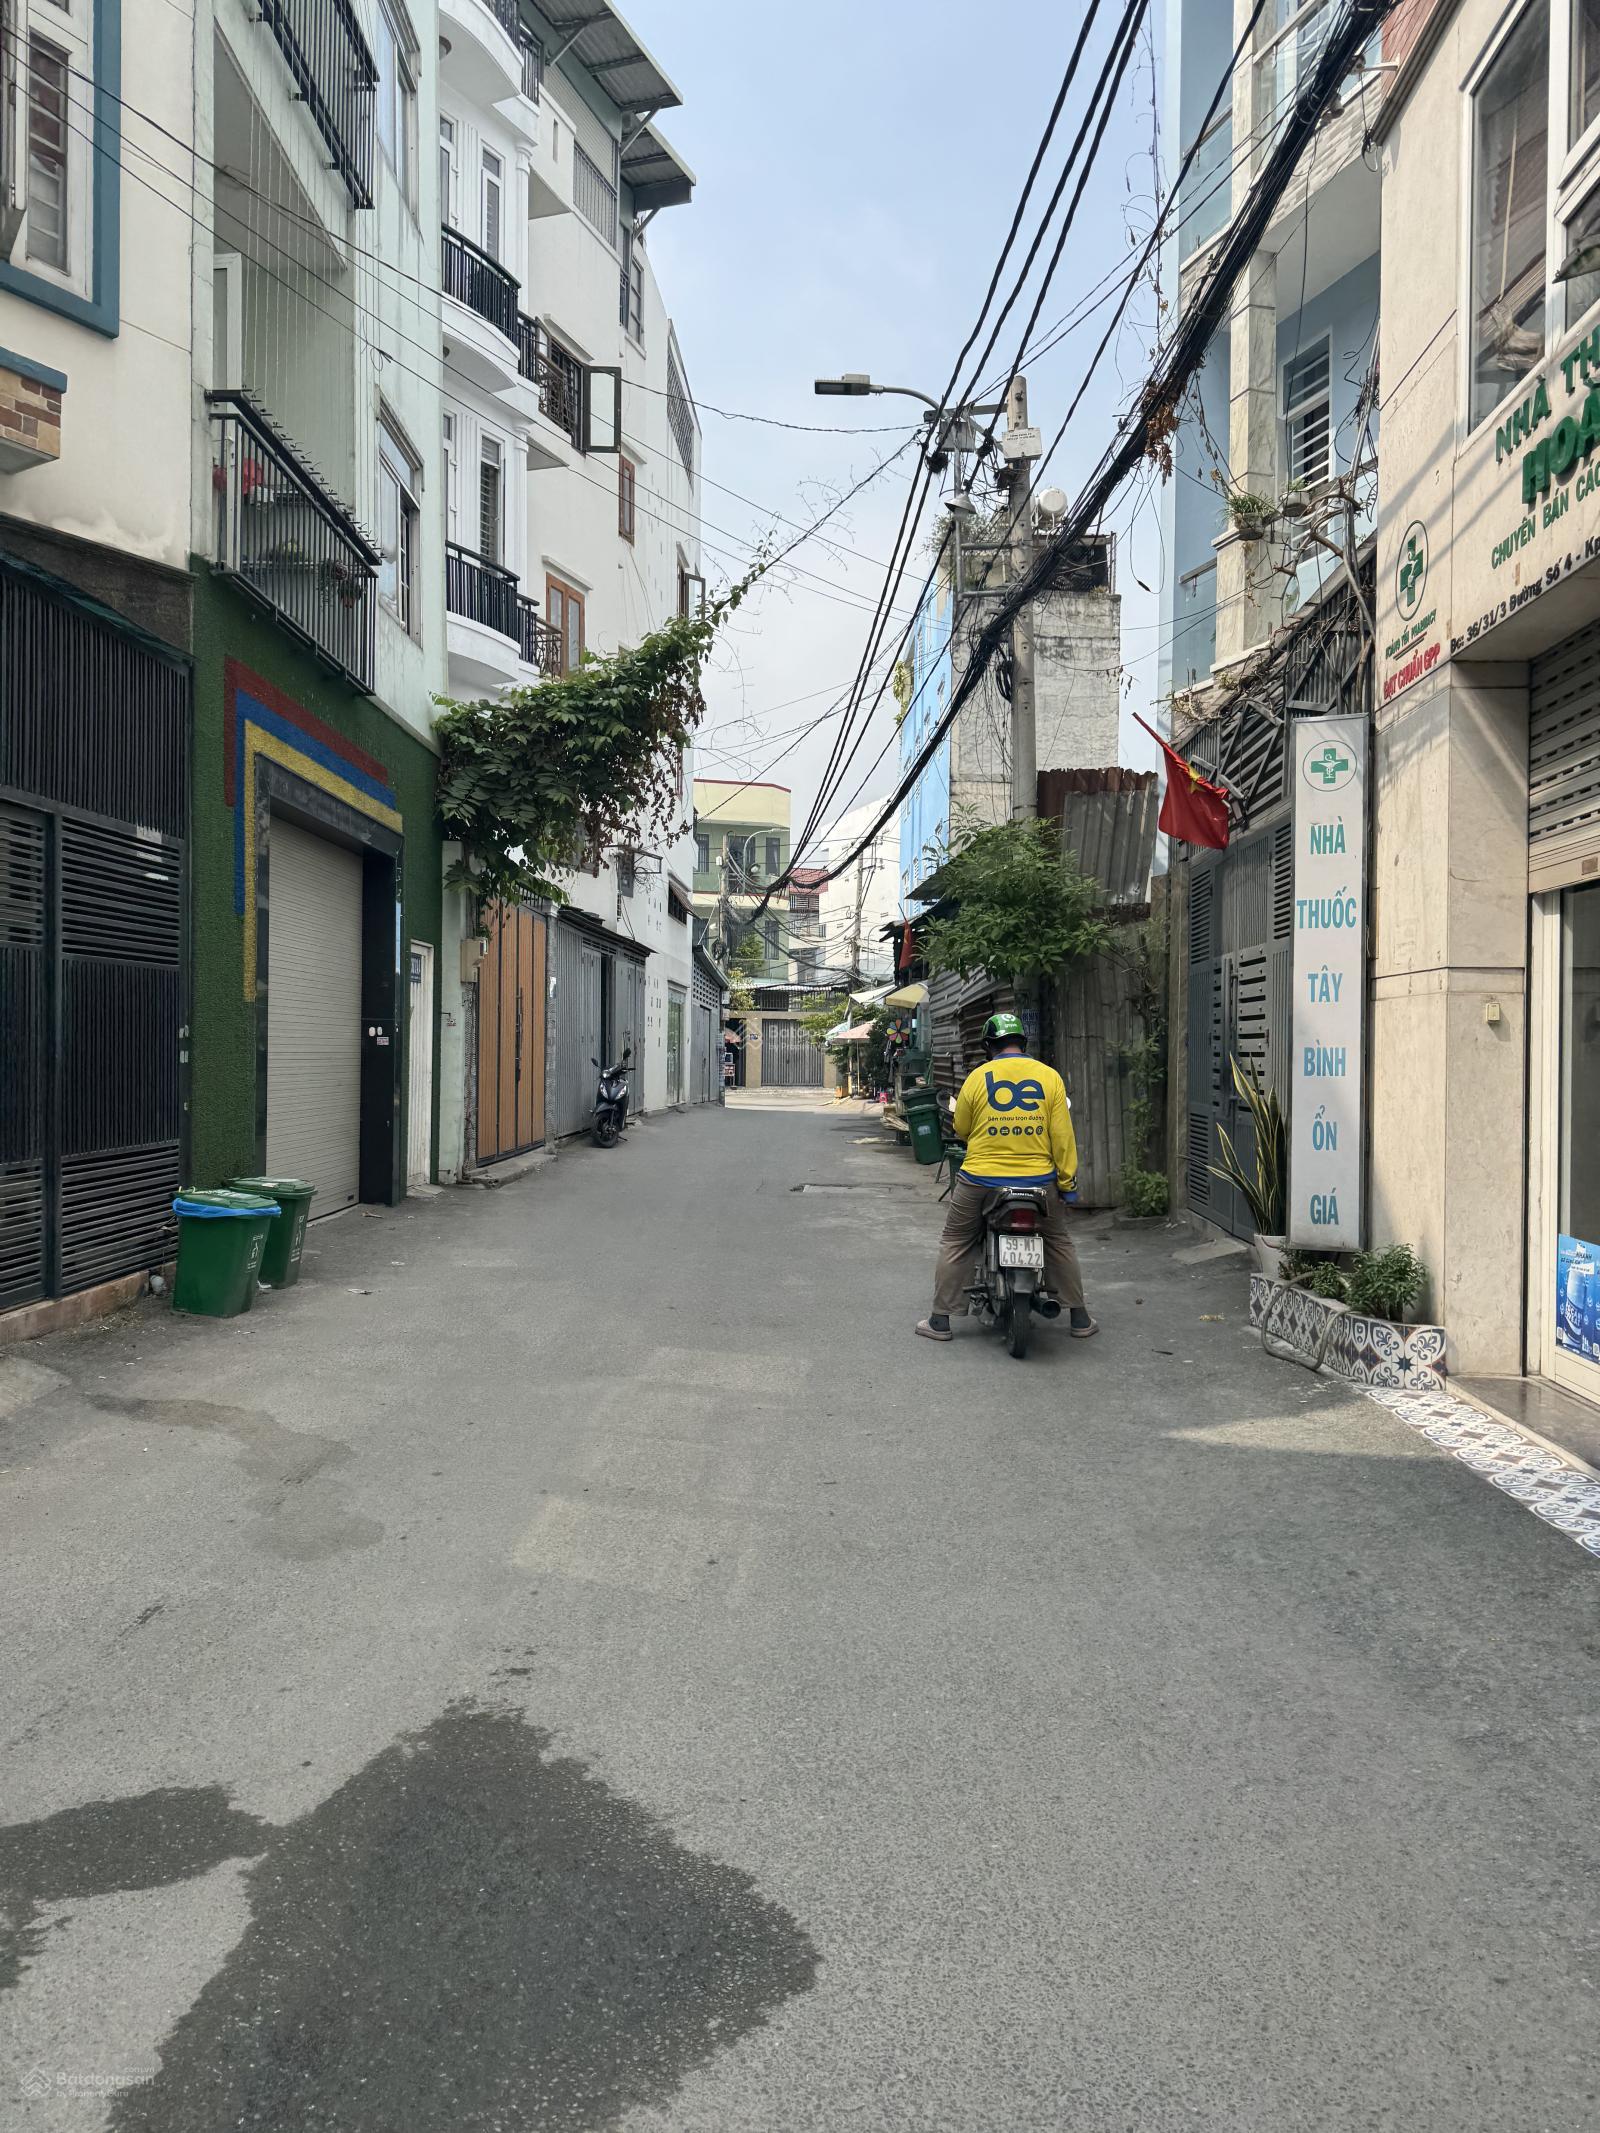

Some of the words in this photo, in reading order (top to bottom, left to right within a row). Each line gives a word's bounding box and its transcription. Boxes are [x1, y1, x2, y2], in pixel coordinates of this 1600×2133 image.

[1496, 374, 1551, 463] NHÀ
[1492, 515, 1536, 569] CHUYÊN
[1543, 488, 1569, 529] BÁN
[1467, 602, 1506, 641] 36/31/3
[1546, 557, 1562, 585] Số
[1564, 553, 1572, 571] 4
[1424, 642, 1440, 671] GPP
[1310, 816, 1346, 855] NHÀ
[1296, 886, 1357, 929] THUỐC
[1307, 965, 1343, 1002] TÂY
[1304, 1040, 1346, 1077] BÌNH
[985, 1071, 1045, 1111] be
[1312, 1105, 1337, 1151] ỔN
[1310, 1187, 1339, 1225] GIÁ
[1003, 1251, 1041, 1266] 404.22
